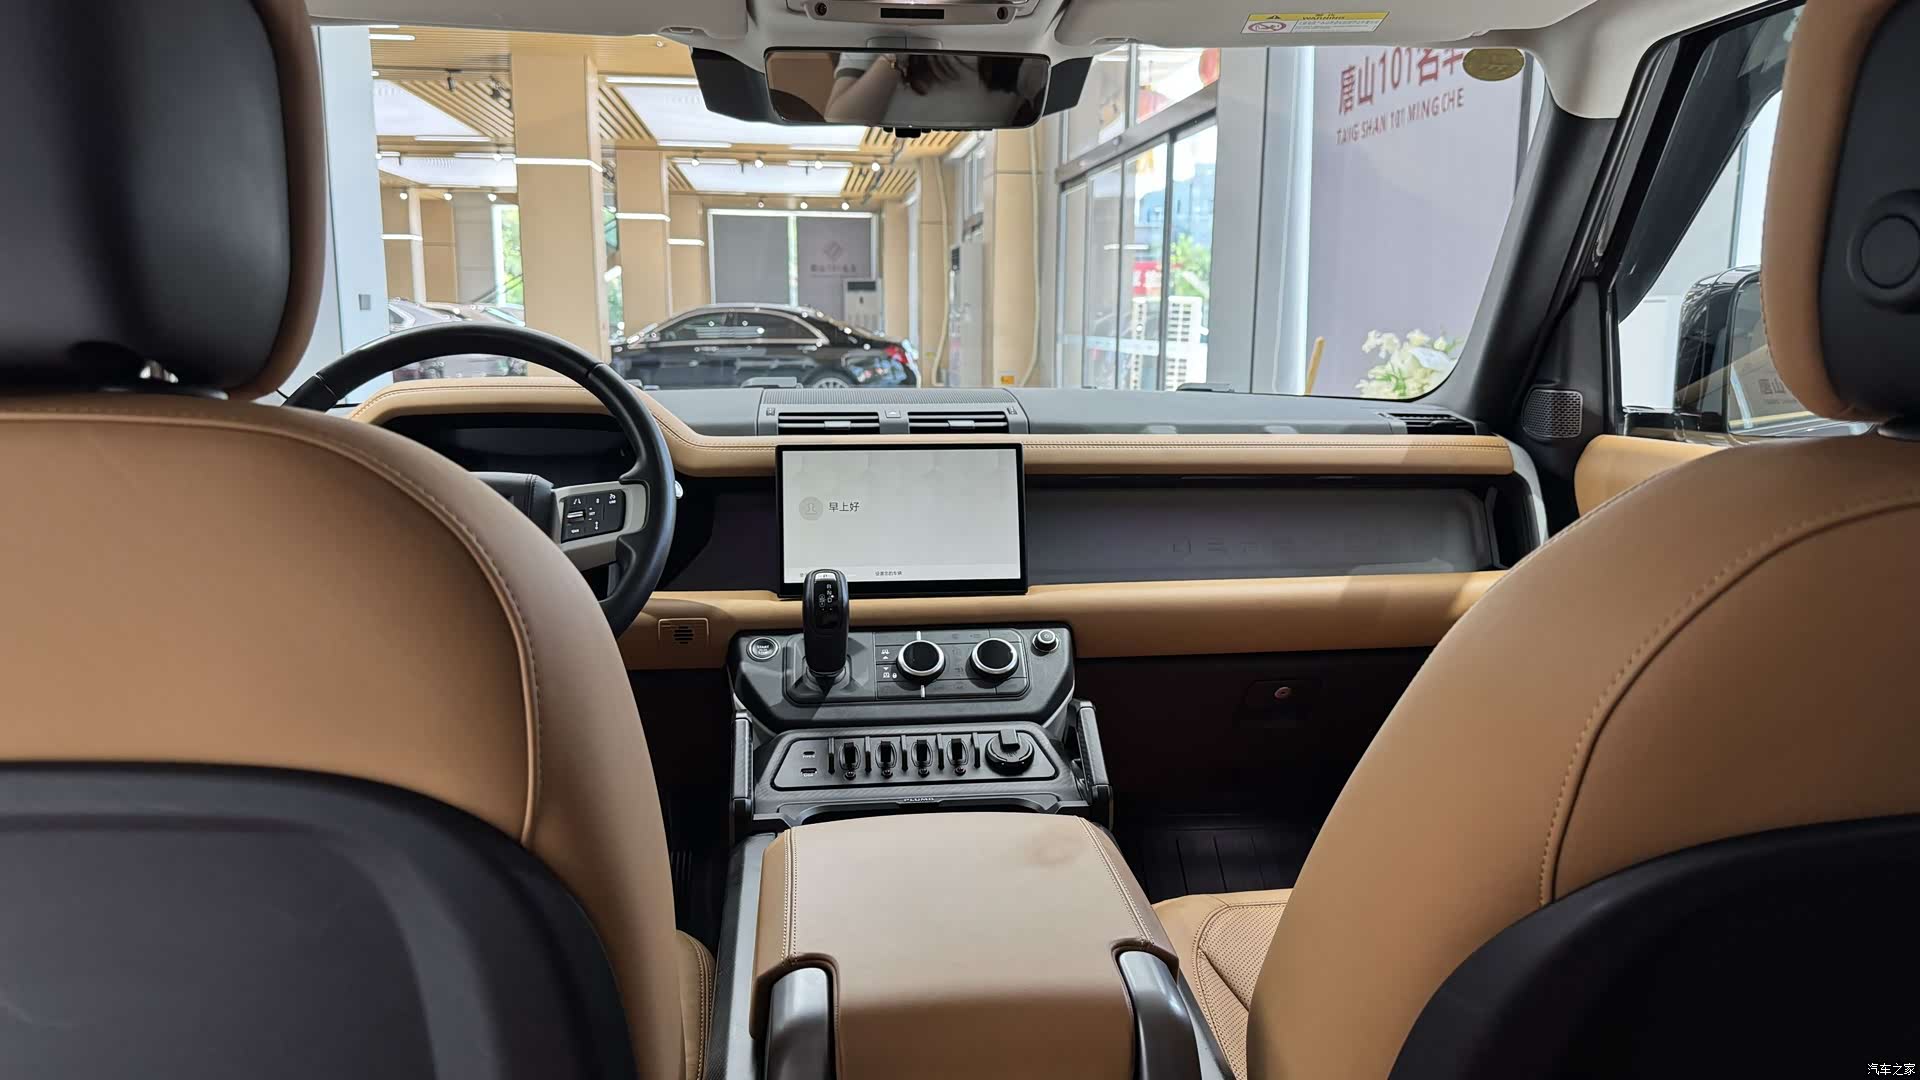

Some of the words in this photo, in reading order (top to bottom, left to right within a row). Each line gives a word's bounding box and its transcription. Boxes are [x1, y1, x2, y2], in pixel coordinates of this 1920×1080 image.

[1336, 124, 1359, 144] TANG
[1361, 113, 1386, 138] SHAN
[829, 501, 860, 513] 早上好
